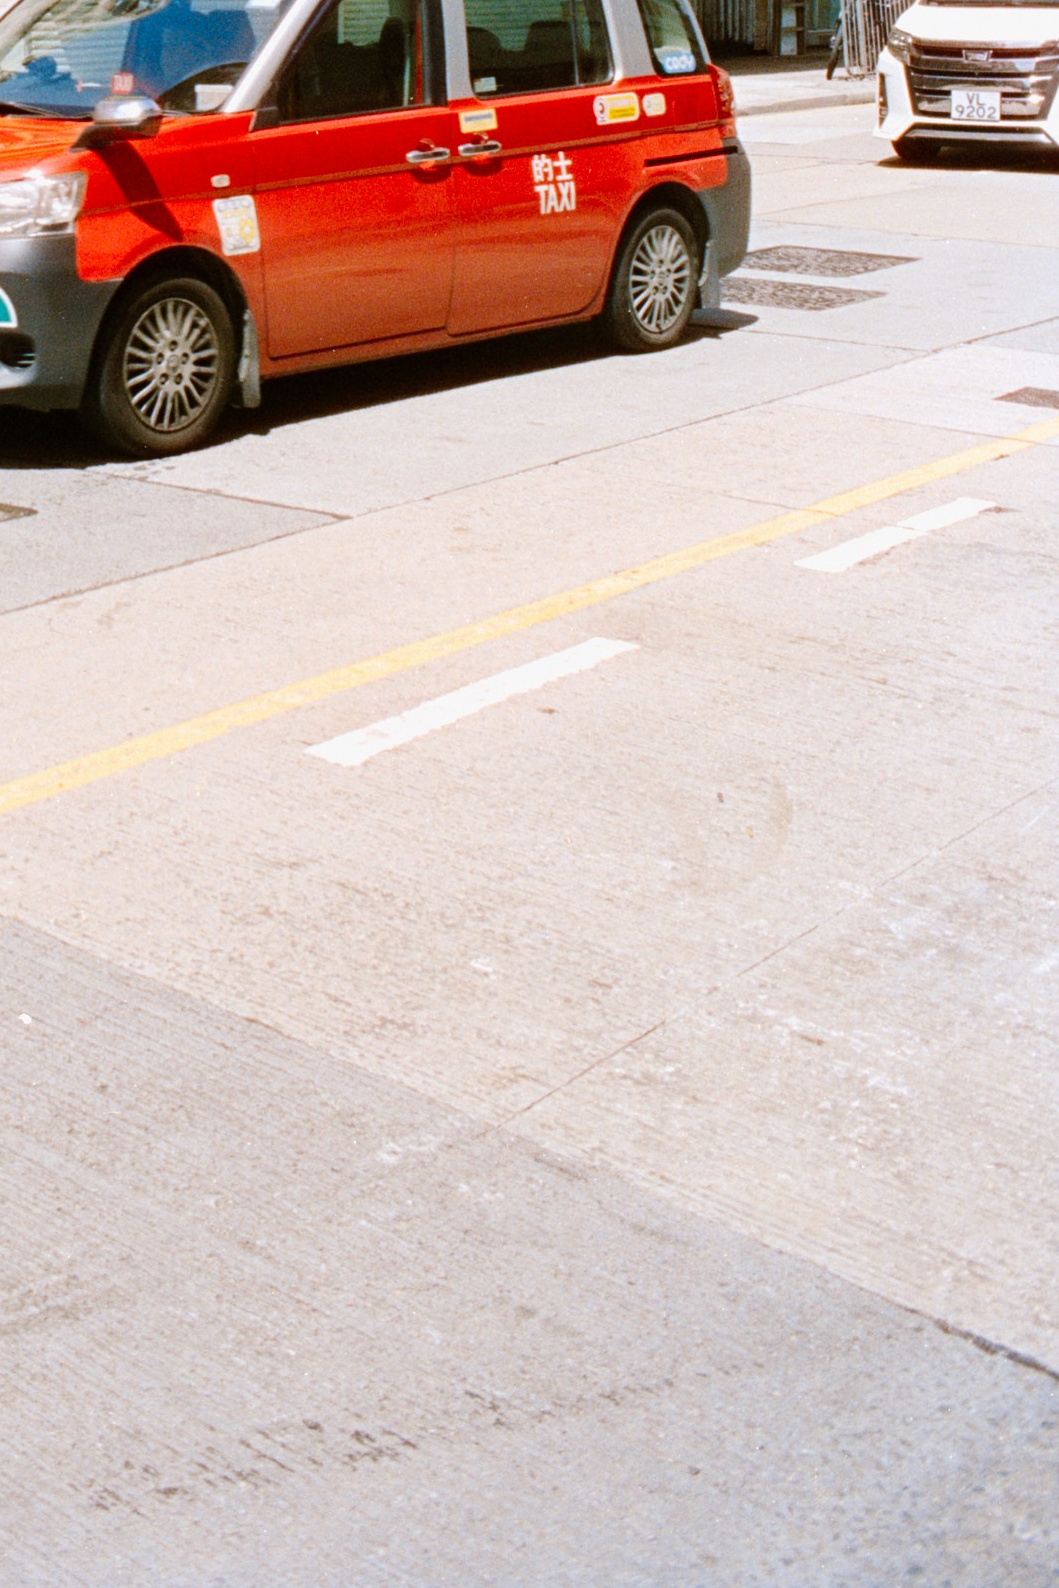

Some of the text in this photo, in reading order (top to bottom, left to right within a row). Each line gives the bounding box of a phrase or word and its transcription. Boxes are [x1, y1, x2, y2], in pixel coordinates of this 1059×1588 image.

[966, 93, 985, 106] VL
[955, 104, 997, 119] 9202
[531, 151, 573, 183] 的士
[534, 181, 576, 215] TAXI
